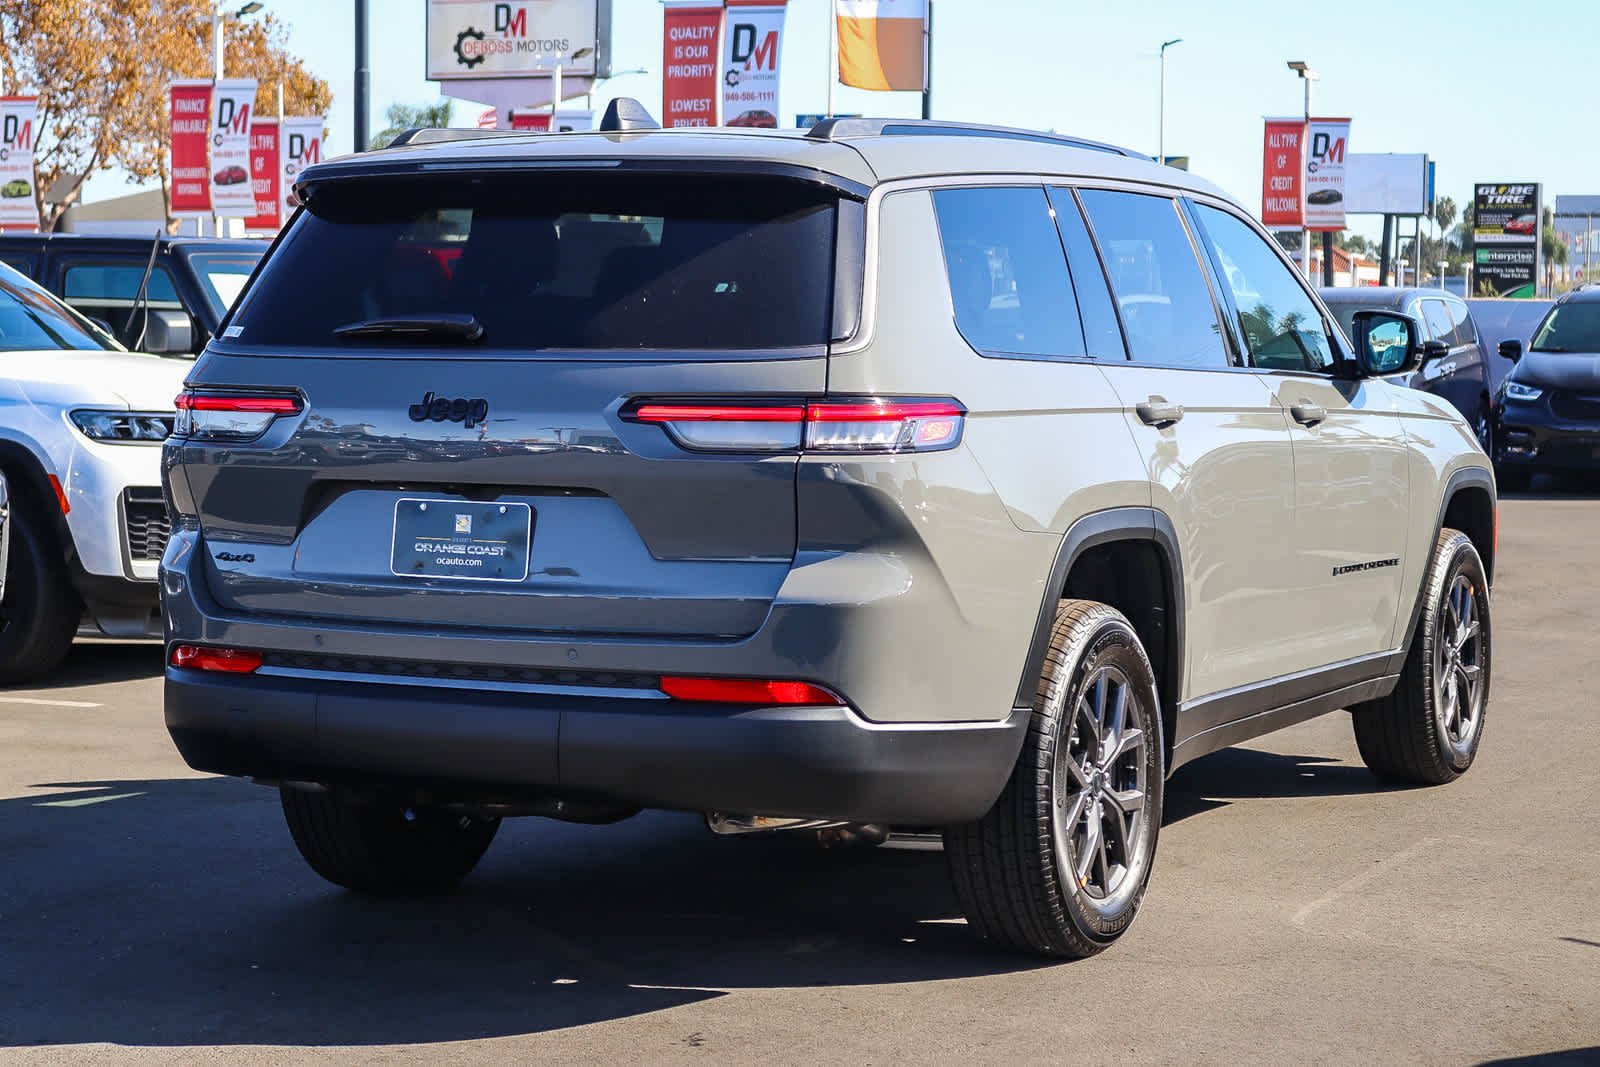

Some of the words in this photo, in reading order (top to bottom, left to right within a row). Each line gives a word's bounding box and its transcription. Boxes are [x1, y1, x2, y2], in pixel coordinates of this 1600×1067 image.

[495, 4, 527, 37] DM
[669, 26, 715, 41] QUALITY
[517, 39, 569, 52] MOTORS
[674, 46, 682, 58] IS
[685, 46, 709, 58] OUR
[731, 23, 779, 71] DM
[668, 64, 714, 78] PRIORITY
[175, 98, 205, 113] FINANCE
[671, 99, 711, 112] LOWEST
[173, 119, 207, 133] AVAILABLE
[1269, 134, 1281, 147] ALL
[1282, 133, 1297, 147] TYPE
[254, 157, 265, 171] OF
[1278, 155, 1286, 168] OF
[1271, 176, 1293, 190] CREDIT
[1266, 197, 1298, 212] WELCOME
[1488, 196, 1526, 204] TIRE
[409, 392, 488, 429] Jeep
[415, 543, 465, 554] ORANGE
[467, 546, 506, 556] COAST
[436, 557, 482, 566] ocauto.com
